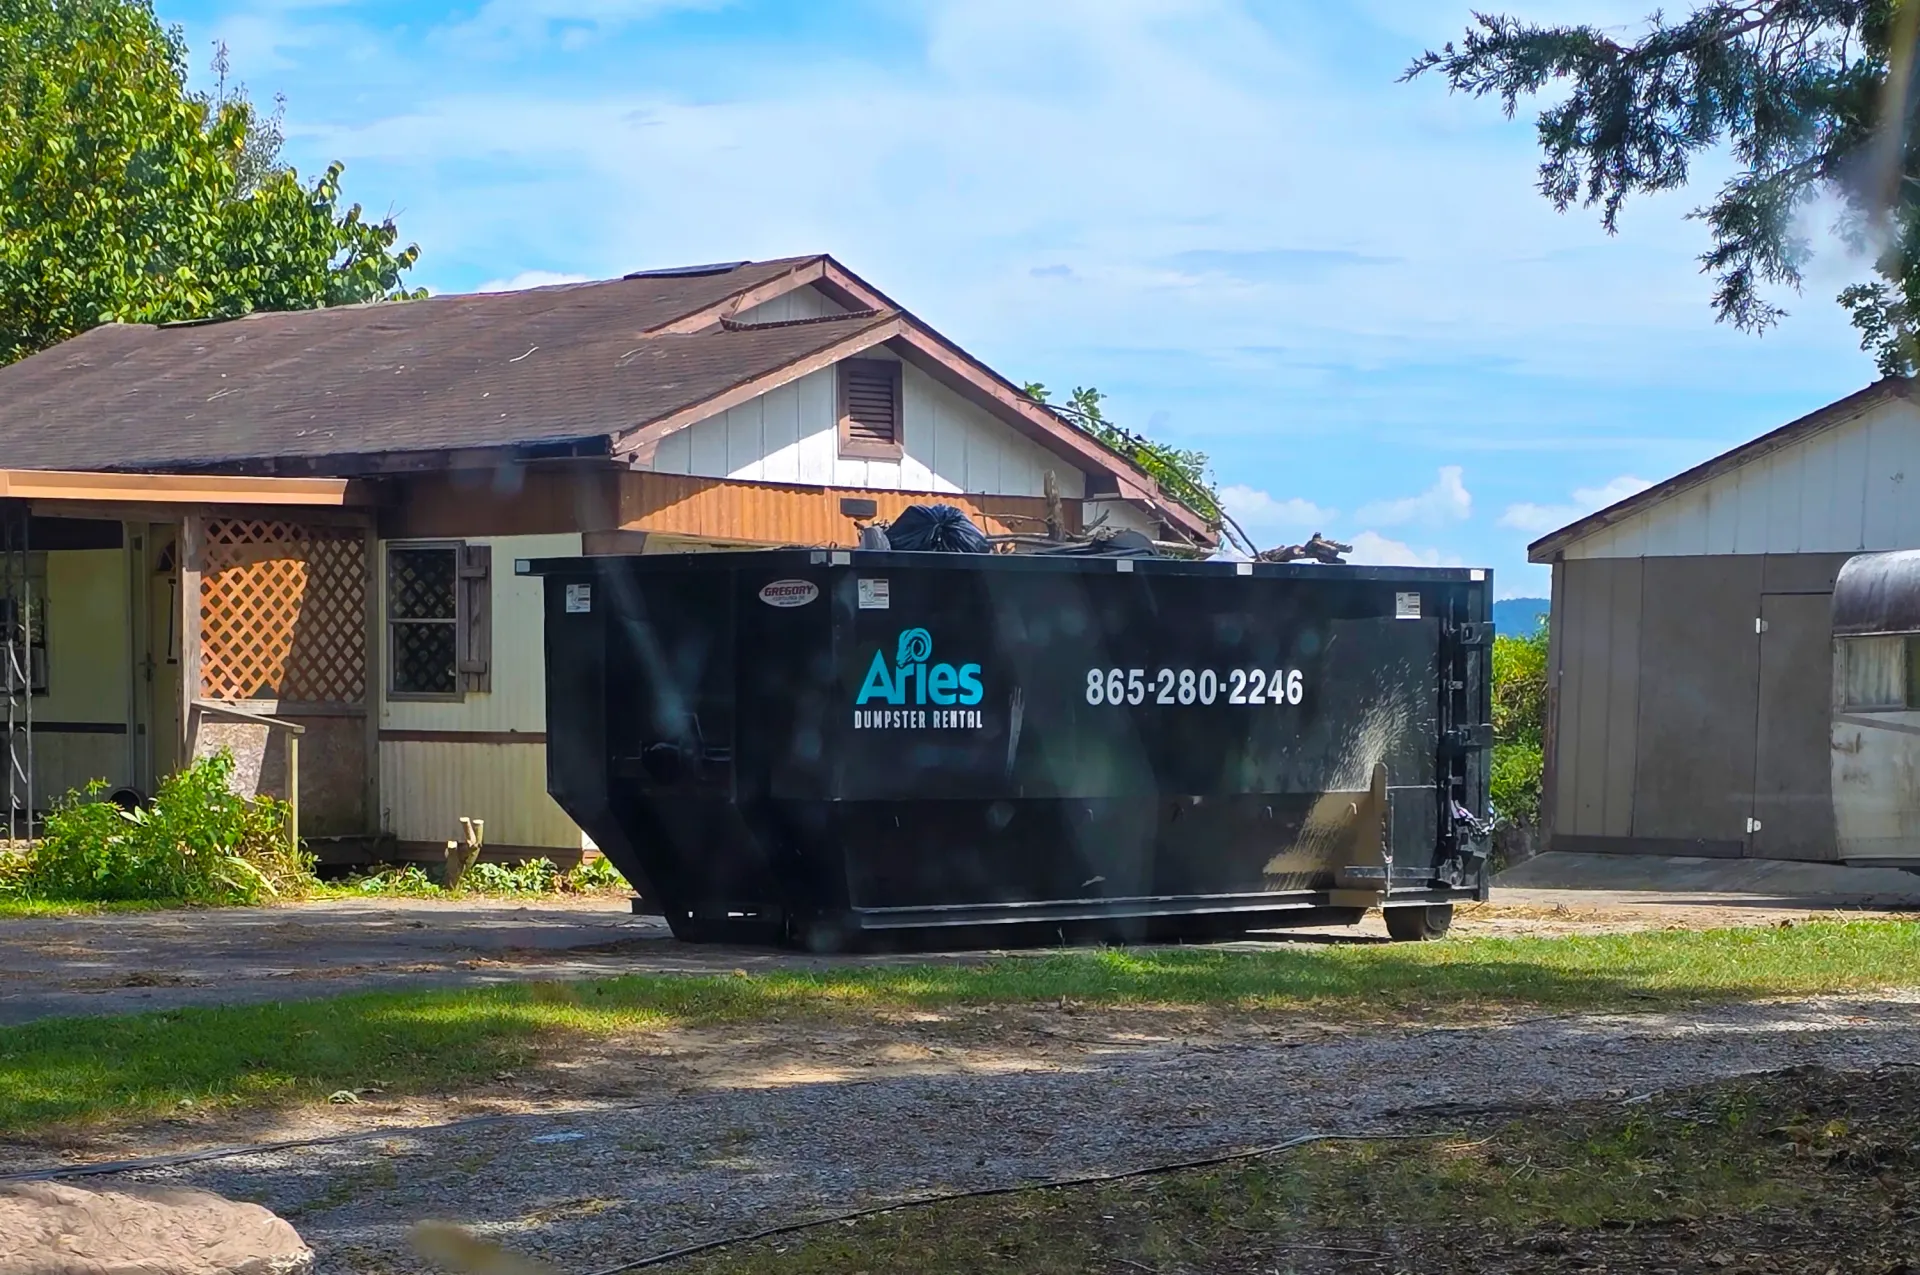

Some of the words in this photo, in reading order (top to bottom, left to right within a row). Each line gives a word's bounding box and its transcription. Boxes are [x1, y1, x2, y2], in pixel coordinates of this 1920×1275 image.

[764, 585, 814, 597] GREGORY
[856, 648, 983, 705] Aries
[854, 710, 926, 729] DUMPSTER
[933, 710, 983, 728] RENTAL
